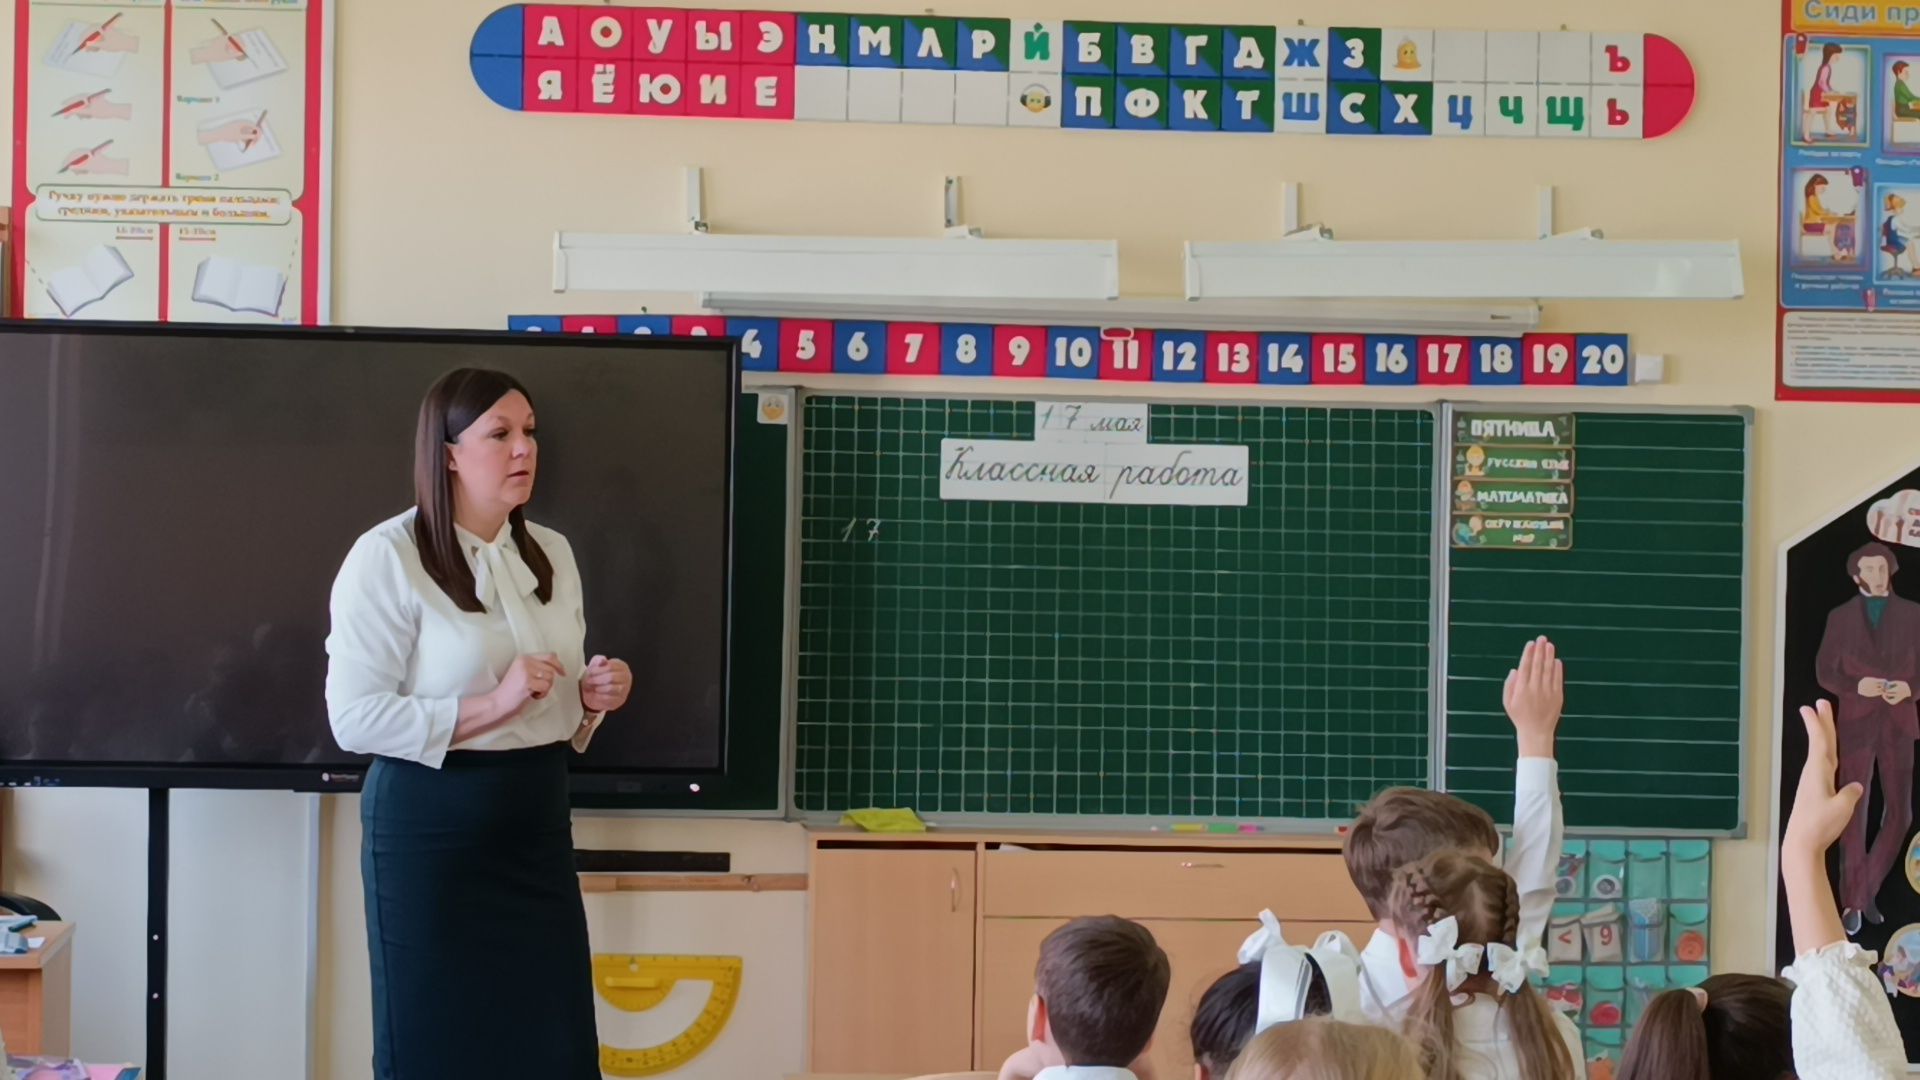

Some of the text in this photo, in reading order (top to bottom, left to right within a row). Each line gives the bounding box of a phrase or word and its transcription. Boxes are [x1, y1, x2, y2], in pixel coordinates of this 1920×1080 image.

[1805, 0, 1876, 23] Сиди
[538, 16, 1631, 72] А О У Ы Э Н М Л Р Й Б В Г Д Ж З Ъ
[538, 64, 1629, 131] Я Ё Ю И Е П Ф К Т Ш С Х Ц Ч Щ Ь
[741, 328, 1624, 375] 4 5 6 7 8 9 10 11 12 13 14 15 16 17 18 19 20
[1089, 417, 1144, 431] мая
[1471, 419, 1555, 437] ПЯТНИЦА
[944, 446, 1244, 499] Классная работа
[1477, 491, 1568, 504] МАТЕМАТИКА
[1600, 925, 1612, 945] 9
